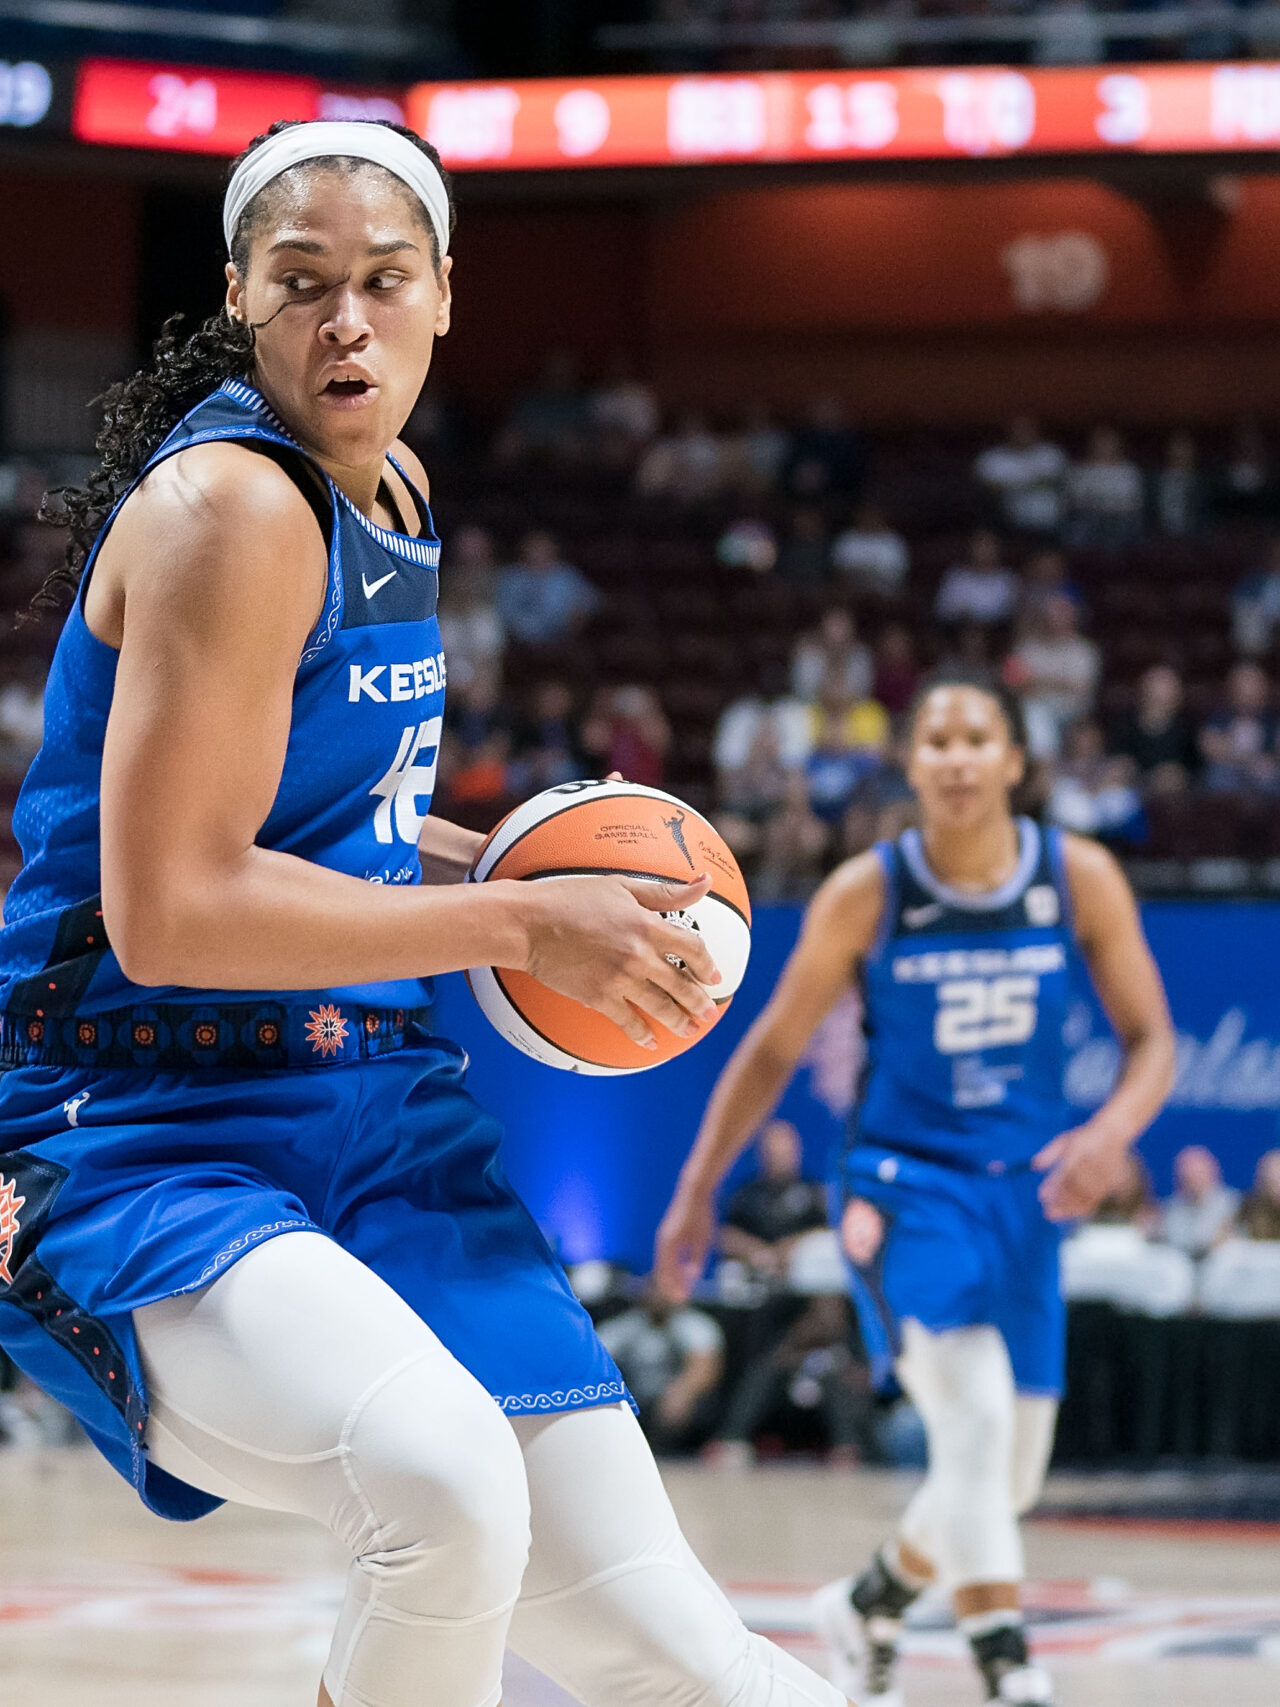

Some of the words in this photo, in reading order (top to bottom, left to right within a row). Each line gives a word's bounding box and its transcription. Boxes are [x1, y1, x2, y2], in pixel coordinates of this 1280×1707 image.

[146, 73, 218, 138] 24
[553, 89, 611, 157] 9
[1095, 73, 1150, 145] 3
[600, 824, 649, 832] OFFICIAL
[934, 975, 1039, 1053] 25
